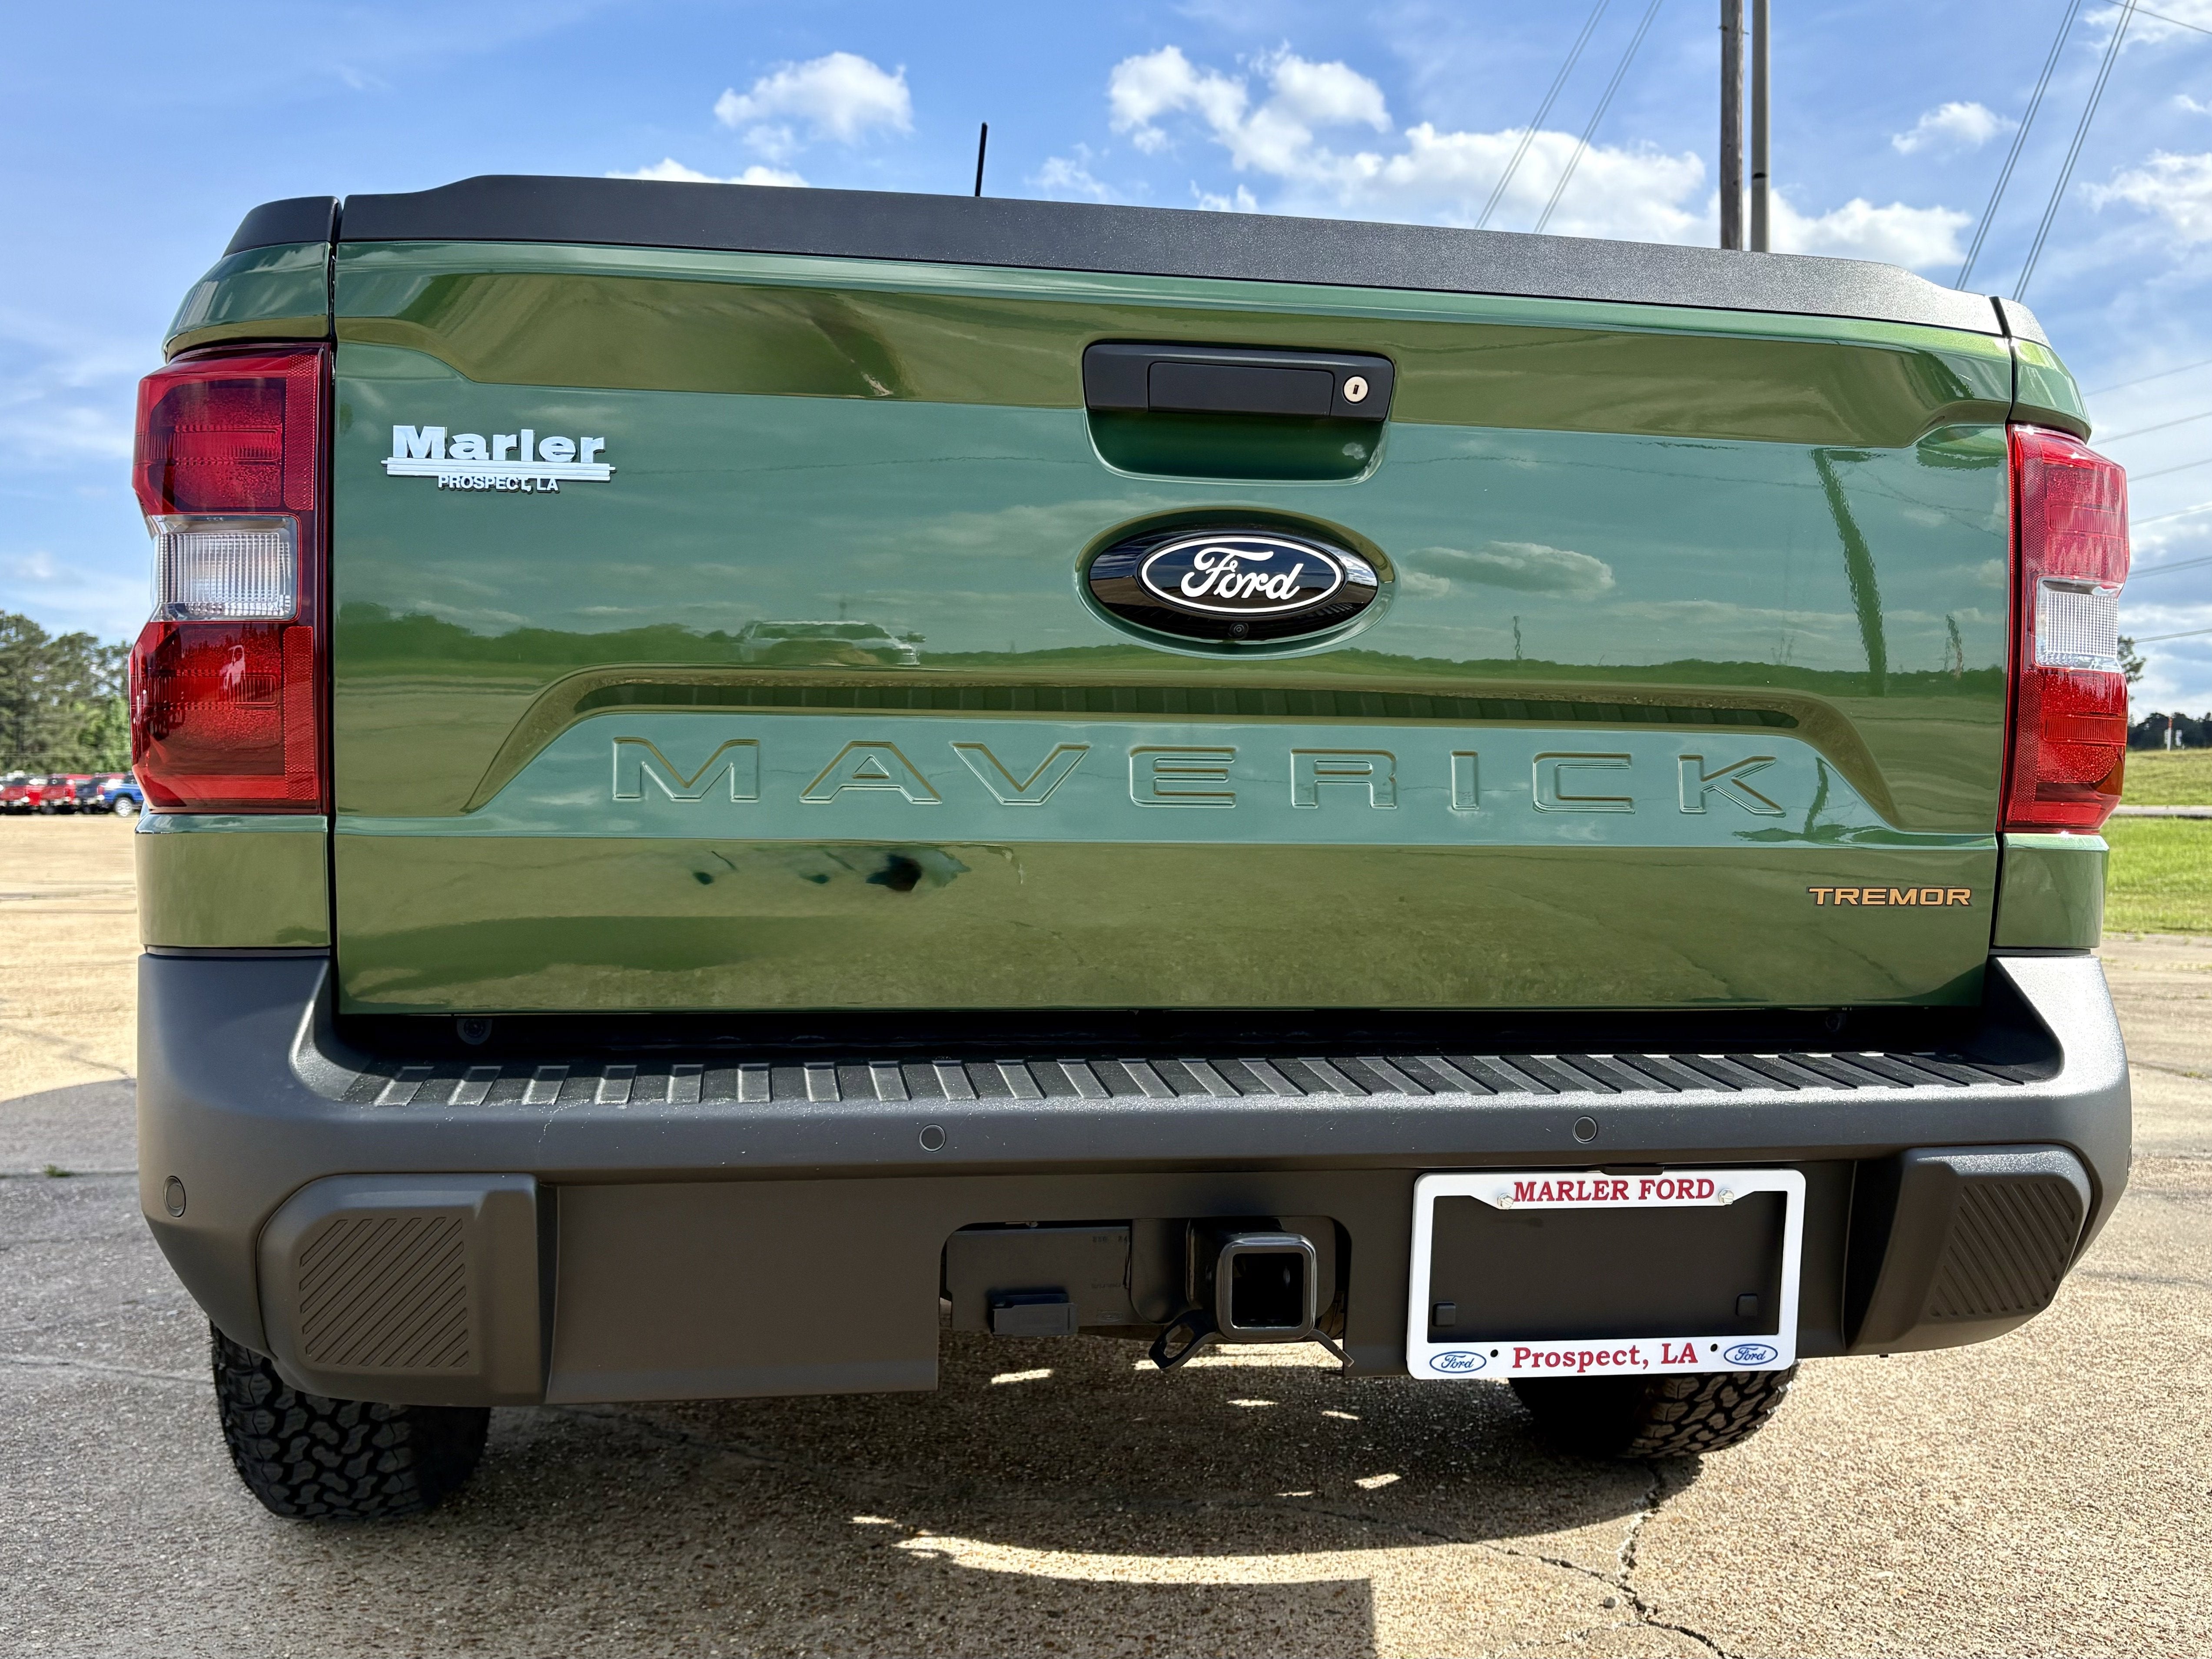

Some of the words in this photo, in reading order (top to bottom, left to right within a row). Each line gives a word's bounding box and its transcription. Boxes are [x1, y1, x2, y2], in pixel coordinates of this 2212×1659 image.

[392, 425, 605, 463] Marler
[438, 475, 532, 492] PROSPECT,
[536, 478, 559, 492] LA
[1181, 547, 1304, 600] Ford
[612, 736, 1786, 818] MAVERICK
[1808, 887, 1971, 905] TREMOR
[1514, 1180, 1629, 1202] MARLER
[1638, 1179, 1715, 1200] FORD
[1441, 1355, 1474, 1369] Ford
[1512, 1345, 1649, 1373] Prospect,
[1661, 1343, 1698, 1364] LA
[1734, 1348, 1766, 1361] Ford
